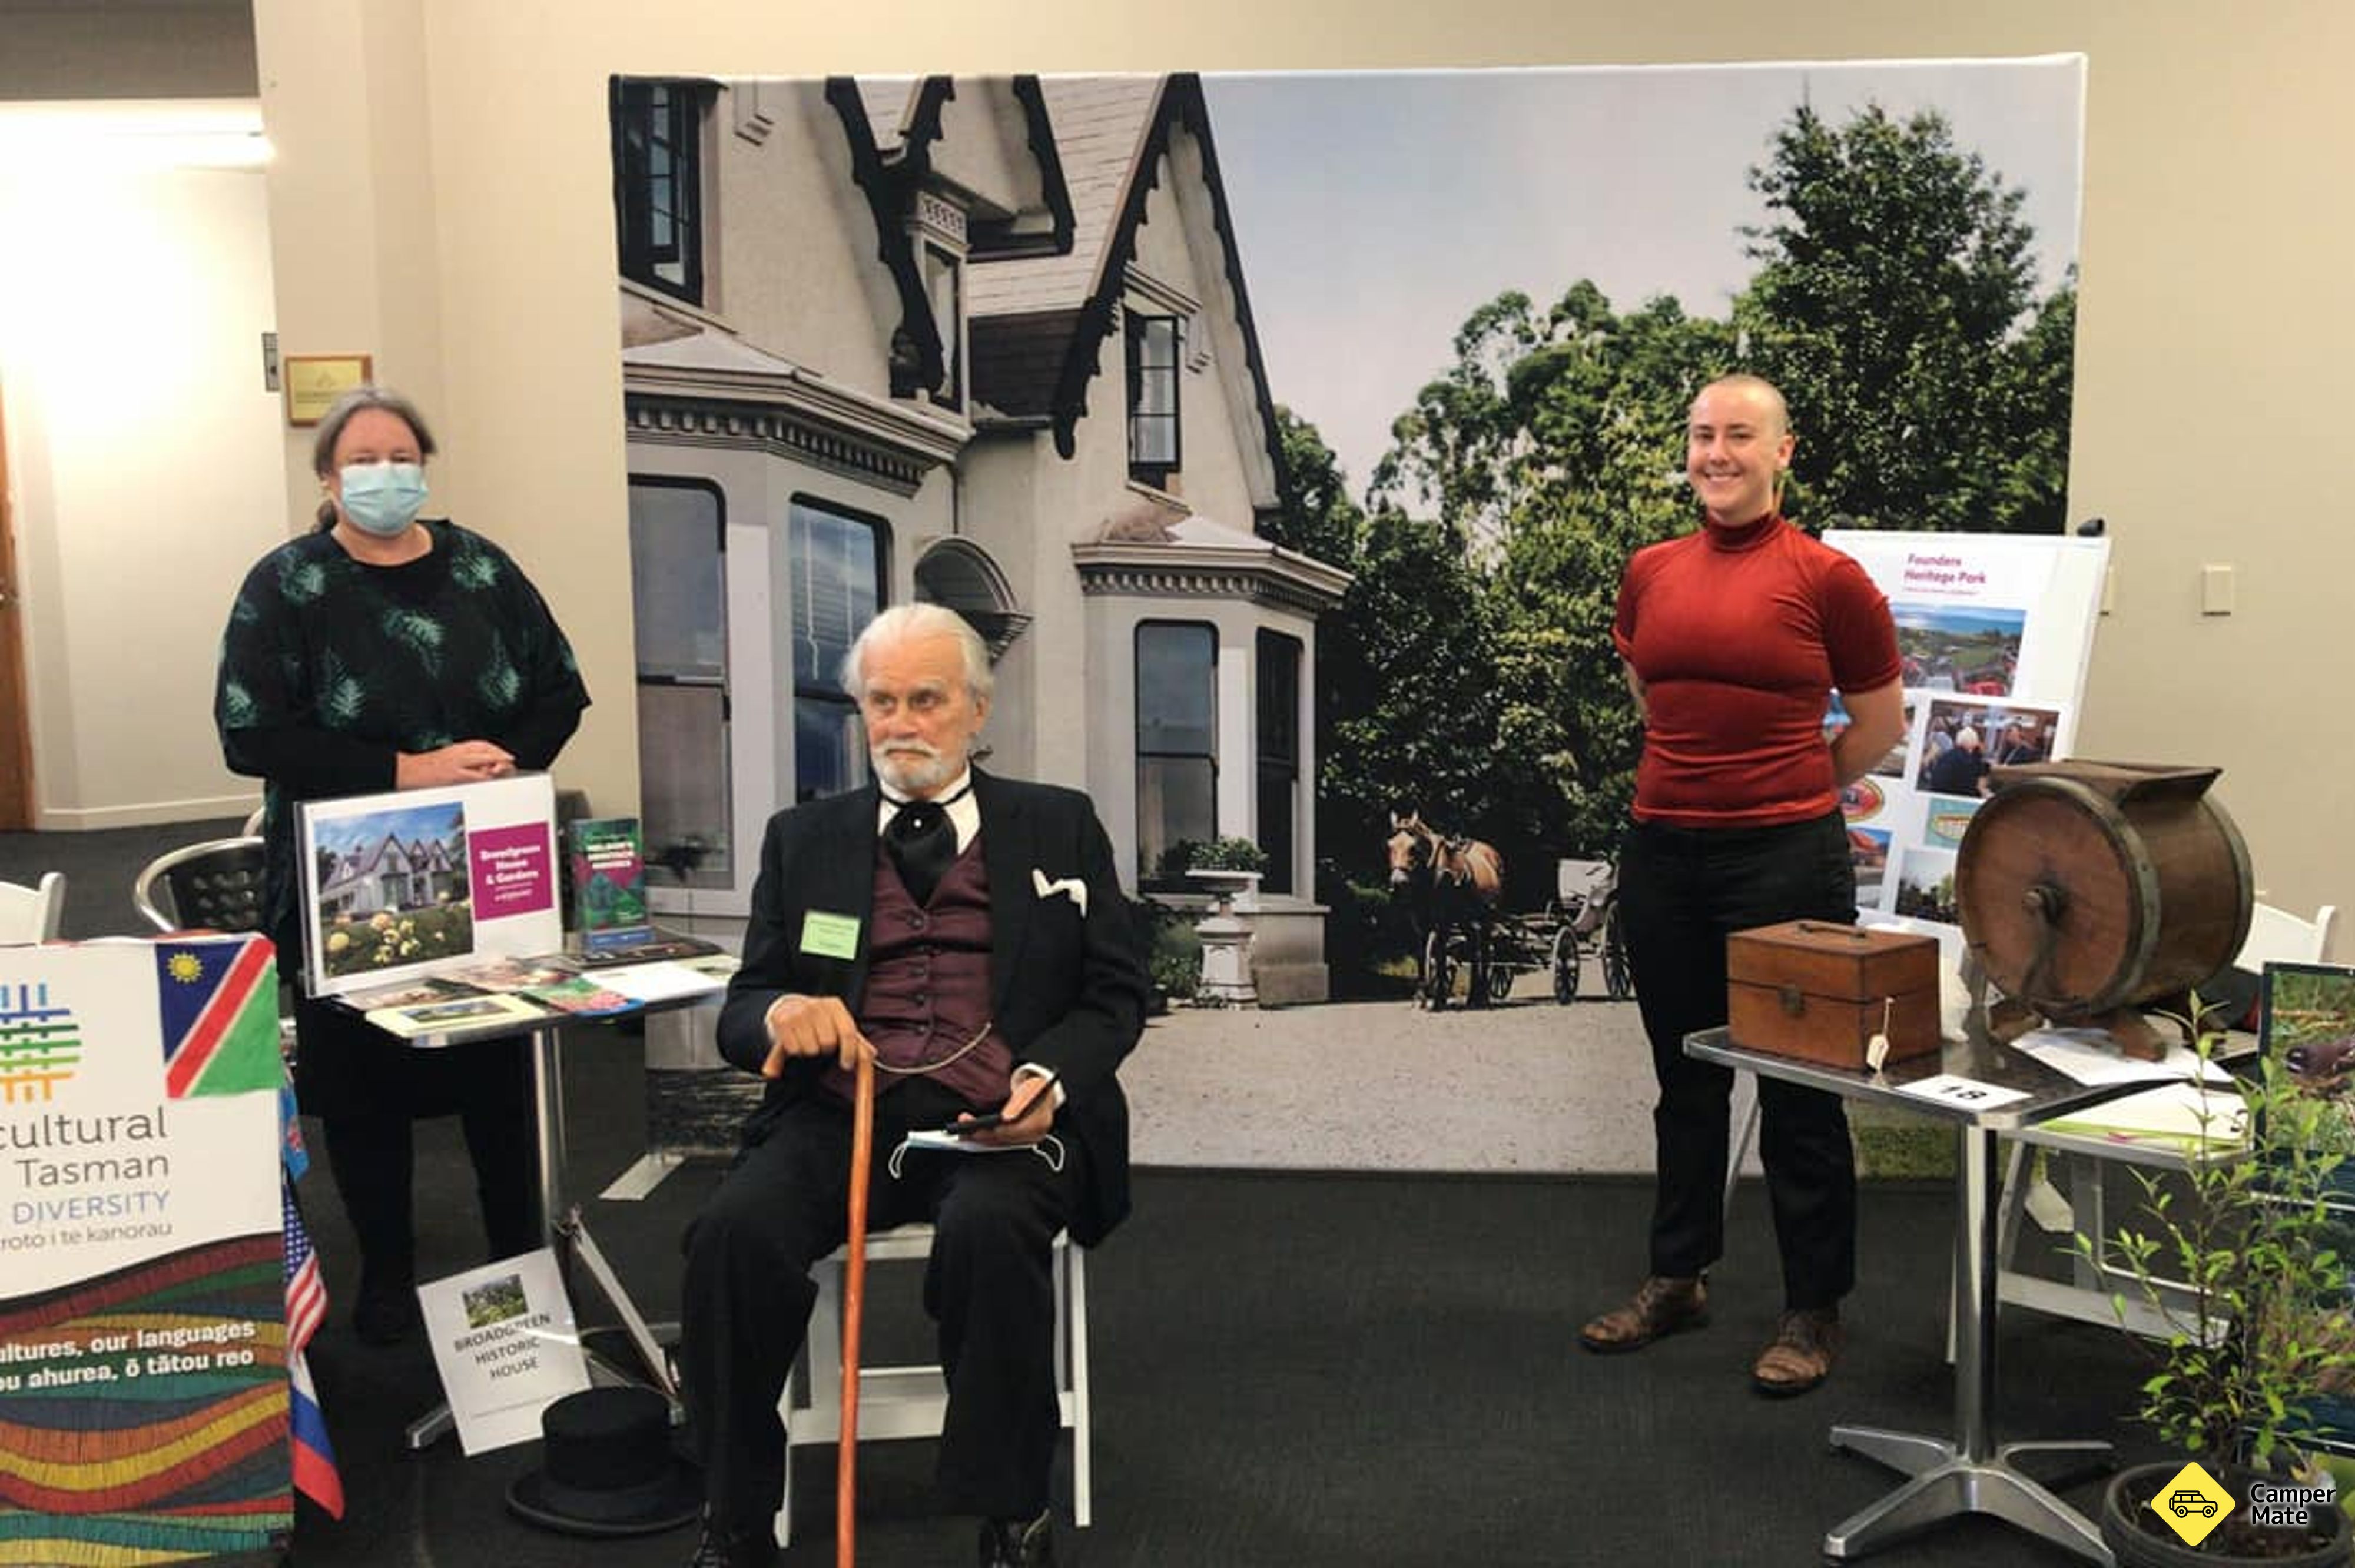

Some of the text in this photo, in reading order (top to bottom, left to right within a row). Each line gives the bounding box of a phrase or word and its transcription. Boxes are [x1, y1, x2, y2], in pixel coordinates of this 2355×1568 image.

[1959, 571, 1986, 584] Park
[15, 1155, 169, 1187] Tasman
[14, 1190, 170, 1224] DIVERSITY
[61, 1230, 82, 1244] te
[87, 1223, 173, 1242] kanorau
[91, 1334, 130, 1353] our
[137, 1321, 256, 1348] languages
[217, 1350, 254, 1368] reo
[474, 1336, 540, 1365] HISTORIC
[490, 1356, 539, 1378] HOUSE
